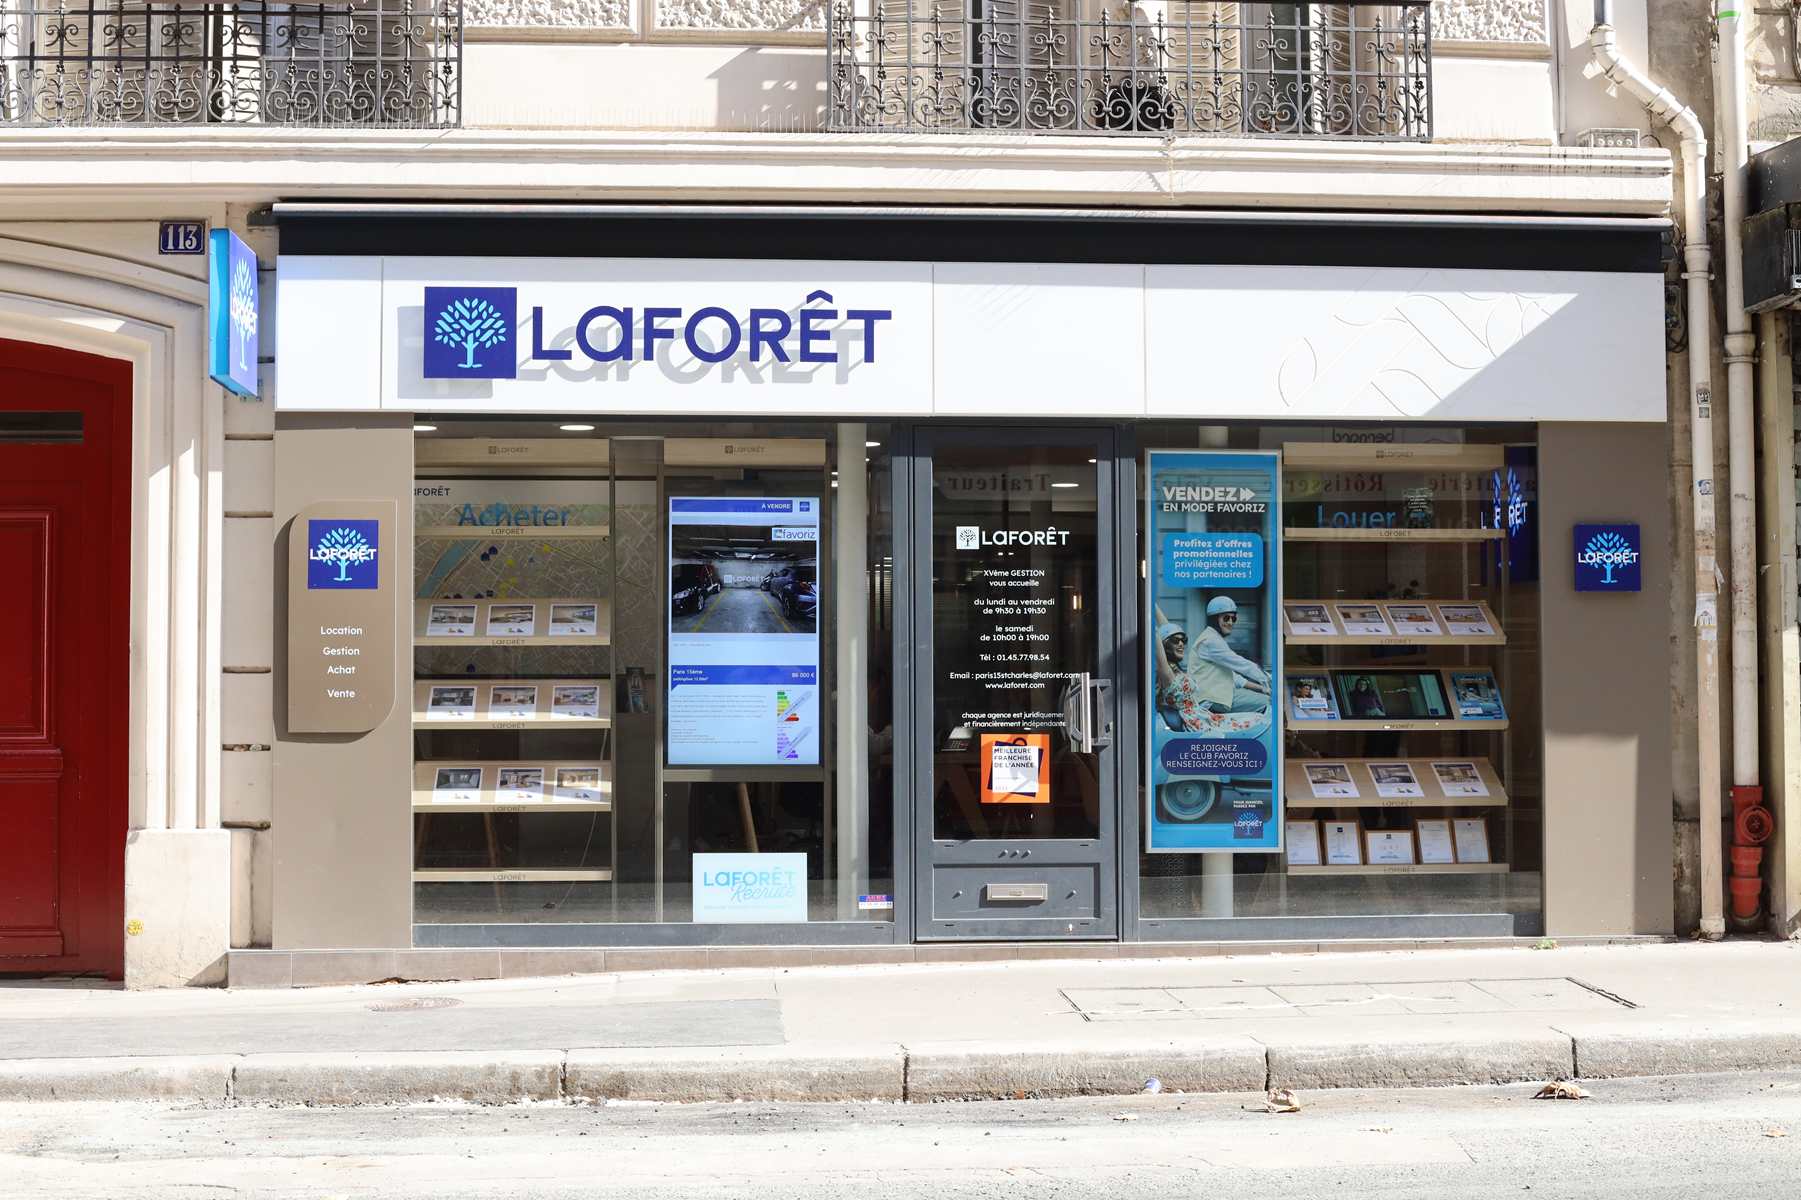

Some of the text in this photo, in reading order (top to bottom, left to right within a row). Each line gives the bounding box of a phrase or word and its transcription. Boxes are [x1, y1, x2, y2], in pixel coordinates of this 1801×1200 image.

[167, 225, 198, 250] 113
[1162, 486, 1237, 501] VENDEZ
[1163, 502, 1266, 513] EN MODE FAVORIZ
[458, 501, 571, 527] Acheter
[1317, 504, 1397, 528] Louer
[1174, 539, 1253, 548] Profitez d'offres
[1173, 550, 1254, 559] promotionnelles
[1174, 560, 1252, 569] privilégiées chez
[983, 569, 1045, 577] XVème GESTION
[1193, 570, 1247, 579] partenaires
[1007, 579, 1040, 587] accueille
[973, 598, 985, 606] du
[986, 598, 1006, 606] lundi
[1020, 598, 1055, 606] vendredi
[982, 607, 1047, 615] de 9h30 à 19h30
[320, 625, 363, 636] Location
[979, 634, 1050, 642] de 10h00 à 19h00
[322, 646, 361, 657] Gestion
[979, 653, 991, 661] Tél
[326, 665, 356, 675] Achat
[327, 689, 356, 699] Vente
[961, 712, 986, 720] chaque
[1190, 744, 1238, 752] REJOIGNEZ
[1179, 752, 1249, 760] LE CLUB FAVORIZ
[1166, 760, 1244, 768] RENSEIGNEZ-VOUS
[1245, 760, 1258, 768] ICI
